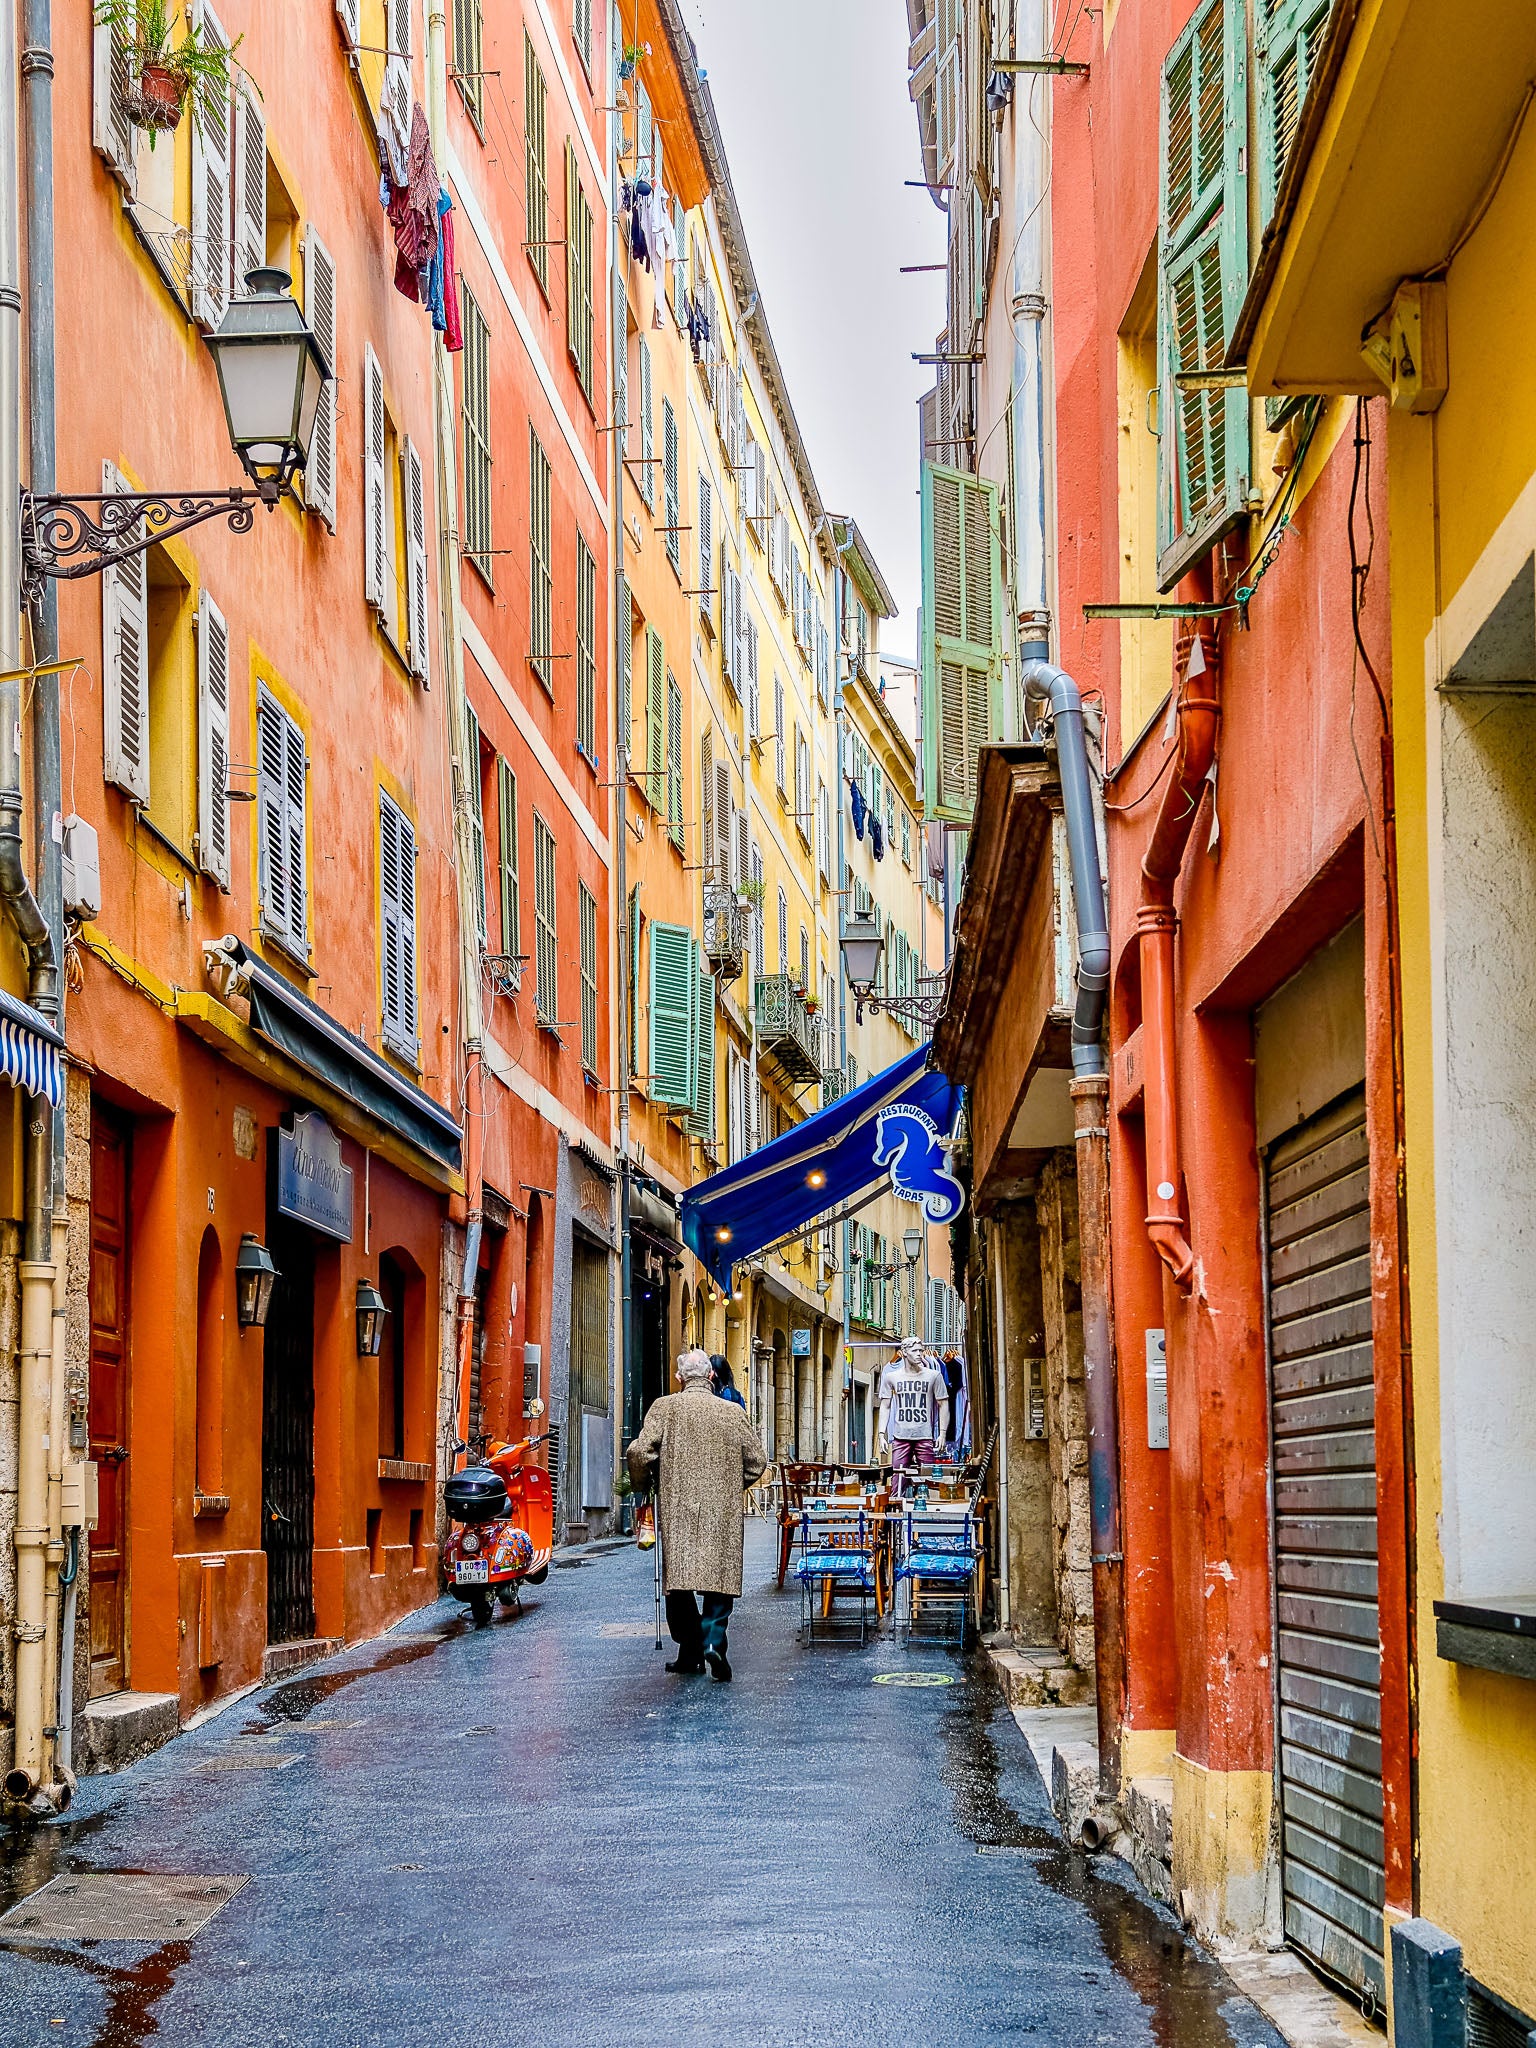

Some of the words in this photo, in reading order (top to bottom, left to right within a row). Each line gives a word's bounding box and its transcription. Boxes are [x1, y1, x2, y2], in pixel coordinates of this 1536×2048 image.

[880, 1105, 937, 1131] RESTAURANT
[893, 1185, 924, 1202] TAPAS
[897, 1392, 917, 1409] I'M
[919, 1393, 927, 1409] A
[898, 1408, 928, 1423] BOSS
[458, 1571, 486, 1581] 960-YJ
